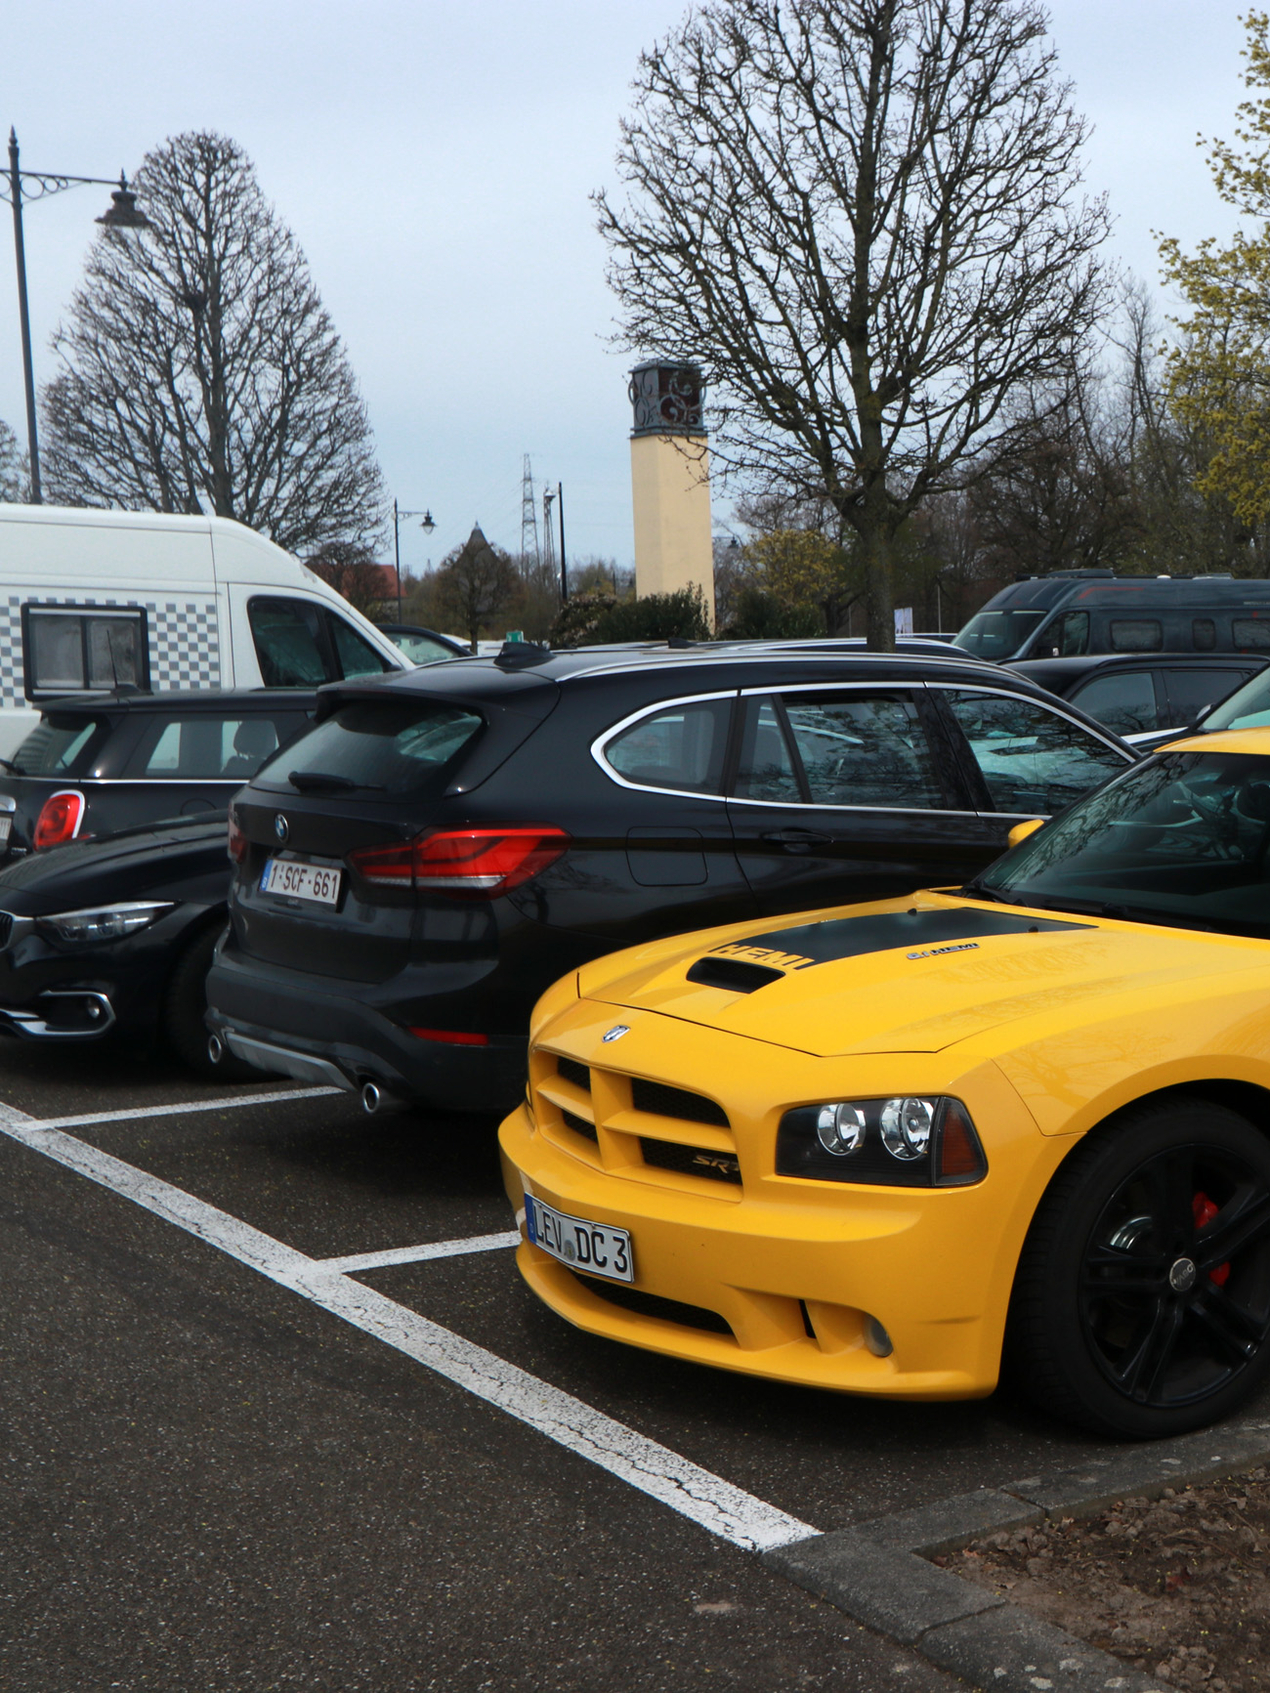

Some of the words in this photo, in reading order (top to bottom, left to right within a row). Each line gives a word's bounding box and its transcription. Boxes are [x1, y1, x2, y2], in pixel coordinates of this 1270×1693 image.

[711, 944, 815, 969] HEMI
[533, 1205, 562, 1253] LEV
[574, 1226, 608, 1268] DC
[613, 1236, 628, 1273] 3
